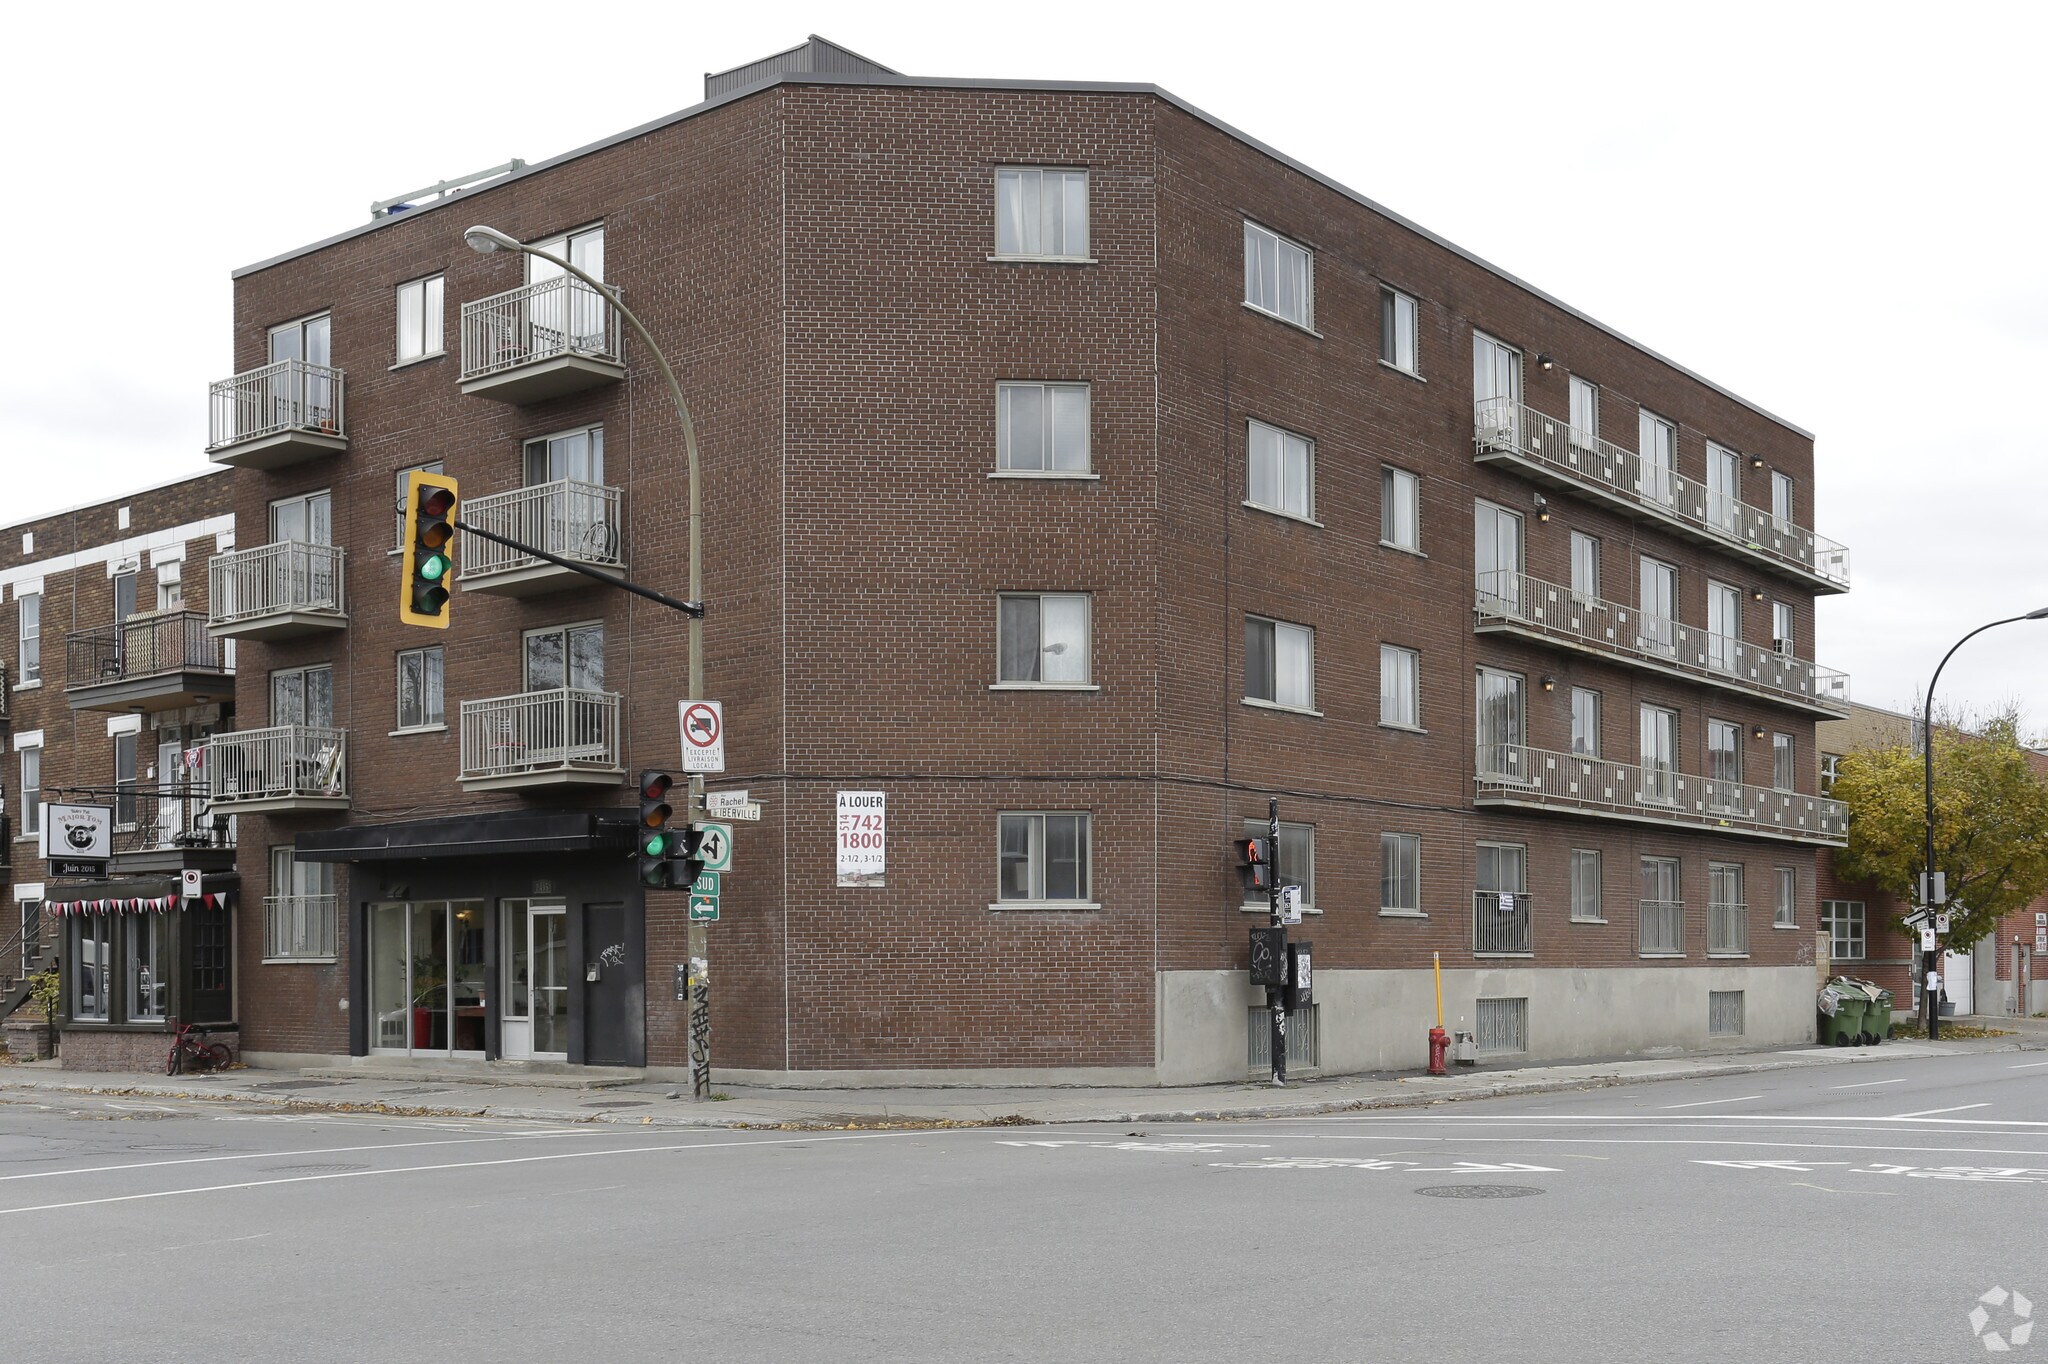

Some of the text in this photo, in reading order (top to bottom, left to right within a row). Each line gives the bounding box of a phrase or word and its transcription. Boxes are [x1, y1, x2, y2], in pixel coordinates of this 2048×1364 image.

[720, 797, 744, 806] Rachel
[839, 793, 883, 808] À LOUER
[839, 814, 882, 831] 514 742
[840, 833, 883, 849] 1800
[63, 863, 96, 874] Juin 2015
[696, 876, 714, 891] SUD
